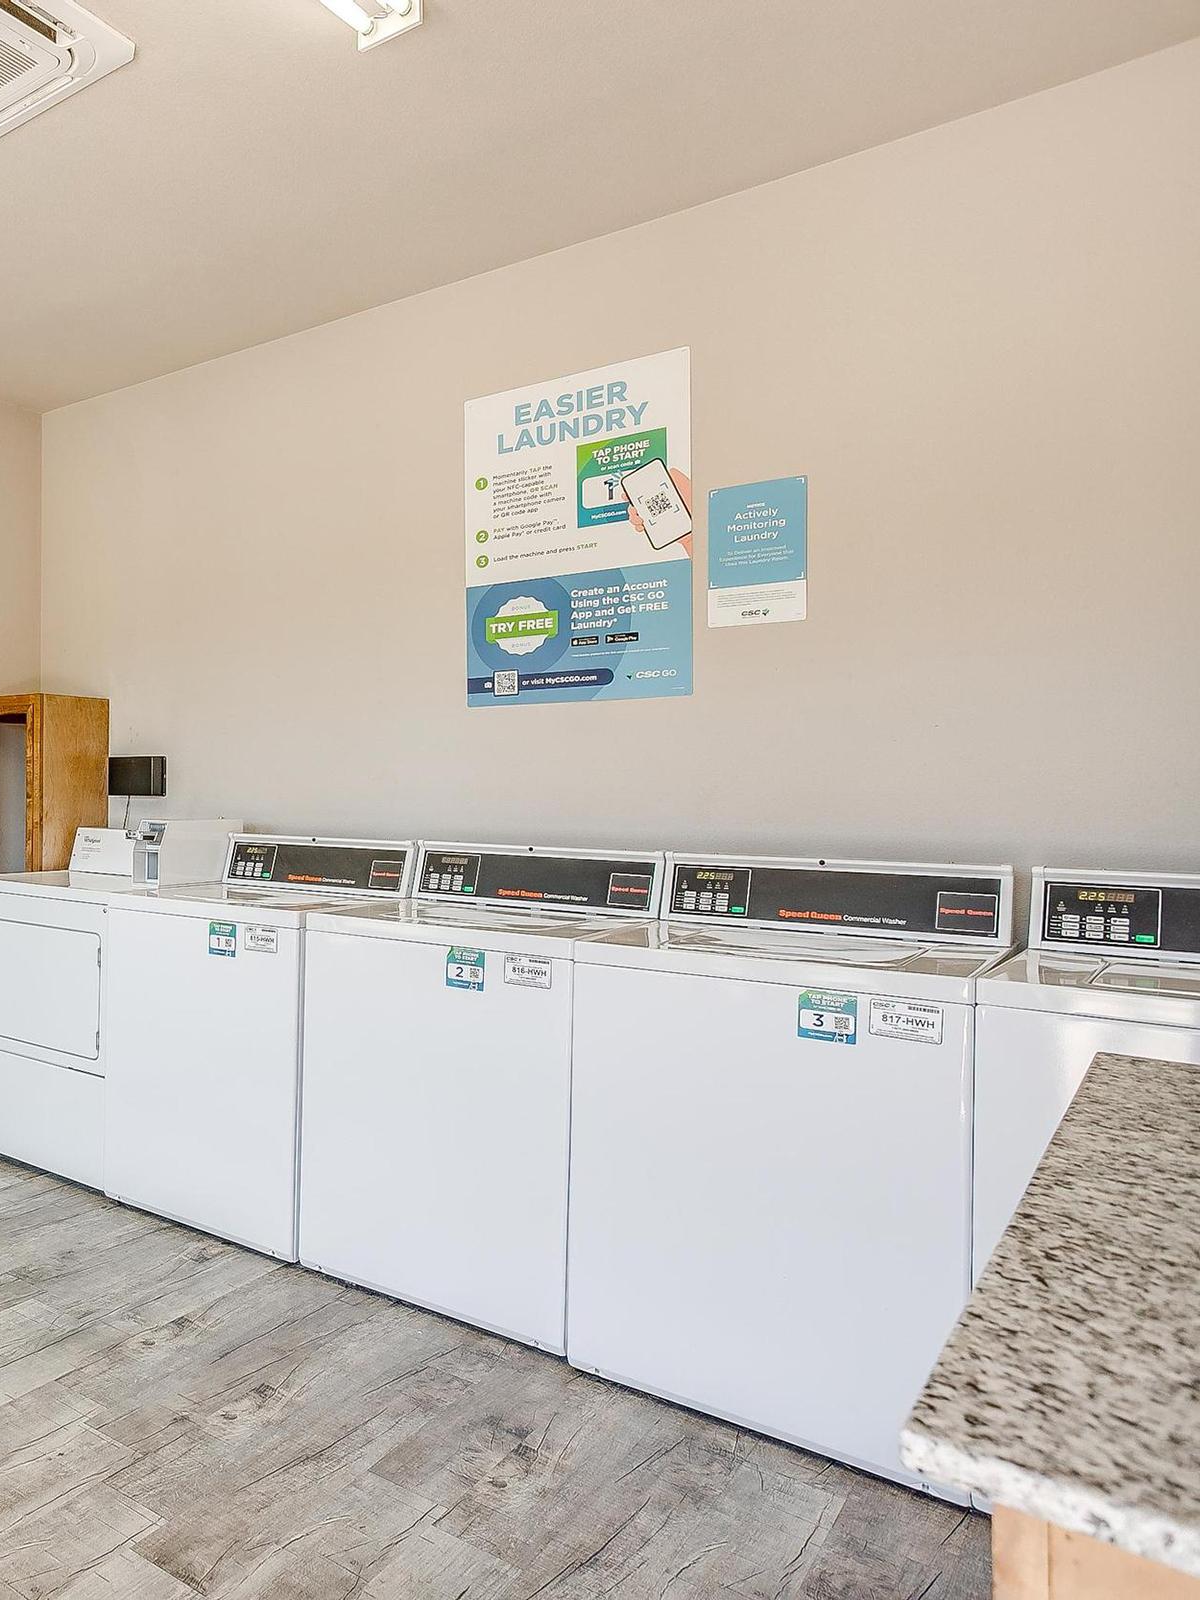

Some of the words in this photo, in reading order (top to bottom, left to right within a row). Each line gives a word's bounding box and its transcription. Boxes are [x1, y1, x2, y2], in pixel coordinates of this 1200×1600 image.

[514, 380, 628, 426] EASIER
[497, 401, 649, 455] LAUNDRY
[592, 448, 612, 458] TAP
[613, 440, 650, 453] PHONE
[596, 456, 610, 465] TO
[612, 448, 646, 462] START
[492, 470, 528, 480] Momentarily
[479, 480, 484, 488] 1
[492, 478, 516, 486] machine
[506, 480, 544, 490] NFC-capable
[498, 497, 522, 505] machine
[507, 500, 542, 510] smartphone
[543, 496, 566, 504] camera
[734, 507, 778, 520] Actively
[520, 521, 541, 530] Google
[727, 518, 786, 533] Monitoring
[478, 532, 486, 542] 2
[493, 532, 510, 540] Apple
[534, 526, 551, 534] credit
[734, 530, 778, 543] Laundry
[519, 549, 544, 558] machine
[478, 557, 486, 566] 3
[570, 587, 604, 598] Create
[606, 586, 620, 594] an
[622, 579, 668, 592] Account
[570, 598, 600, 609] Using
[602, 596, 620, 605] the
[622, 592, 645, 603] CSC
[647, 590, 665, 600] GO
[570, 610, 592, 620] App
[594, 607, 615, 618] and
[617, 605, 636, 614] Get
[638, 601, 669, 612] FREE
[489, 621, 515, 634] TRY
[518, 618, 554, 631] FREE
[530, 677, 545, 685] visit
[545, 674, 597, 685] MyCSCGO.com
[635, 670, 660, 679] CSC
[661, 668, 677, 678] GO
[288, 874, 304, 882] Speed
[497, 888, 520, 897] Speed
[520, 890, 543, 898] Queen
[543, 892, 570, 900] Commercial
[939, 906, 966, 915] Speed
[778, 909, 810, 919] Speed
[810, 911, 842, 921] Queen
[842, 914, 882, 924] Commercial
[882, 917, 907, 926] Washer
[216, 937, 221, 948] 1
[455, 966, 464, 978] 2
[511, 966, 547, 977] 816-HWH
[812, 1013, 824, 1027] 3
[881, 1014, 935, 1030] 817-HWH
